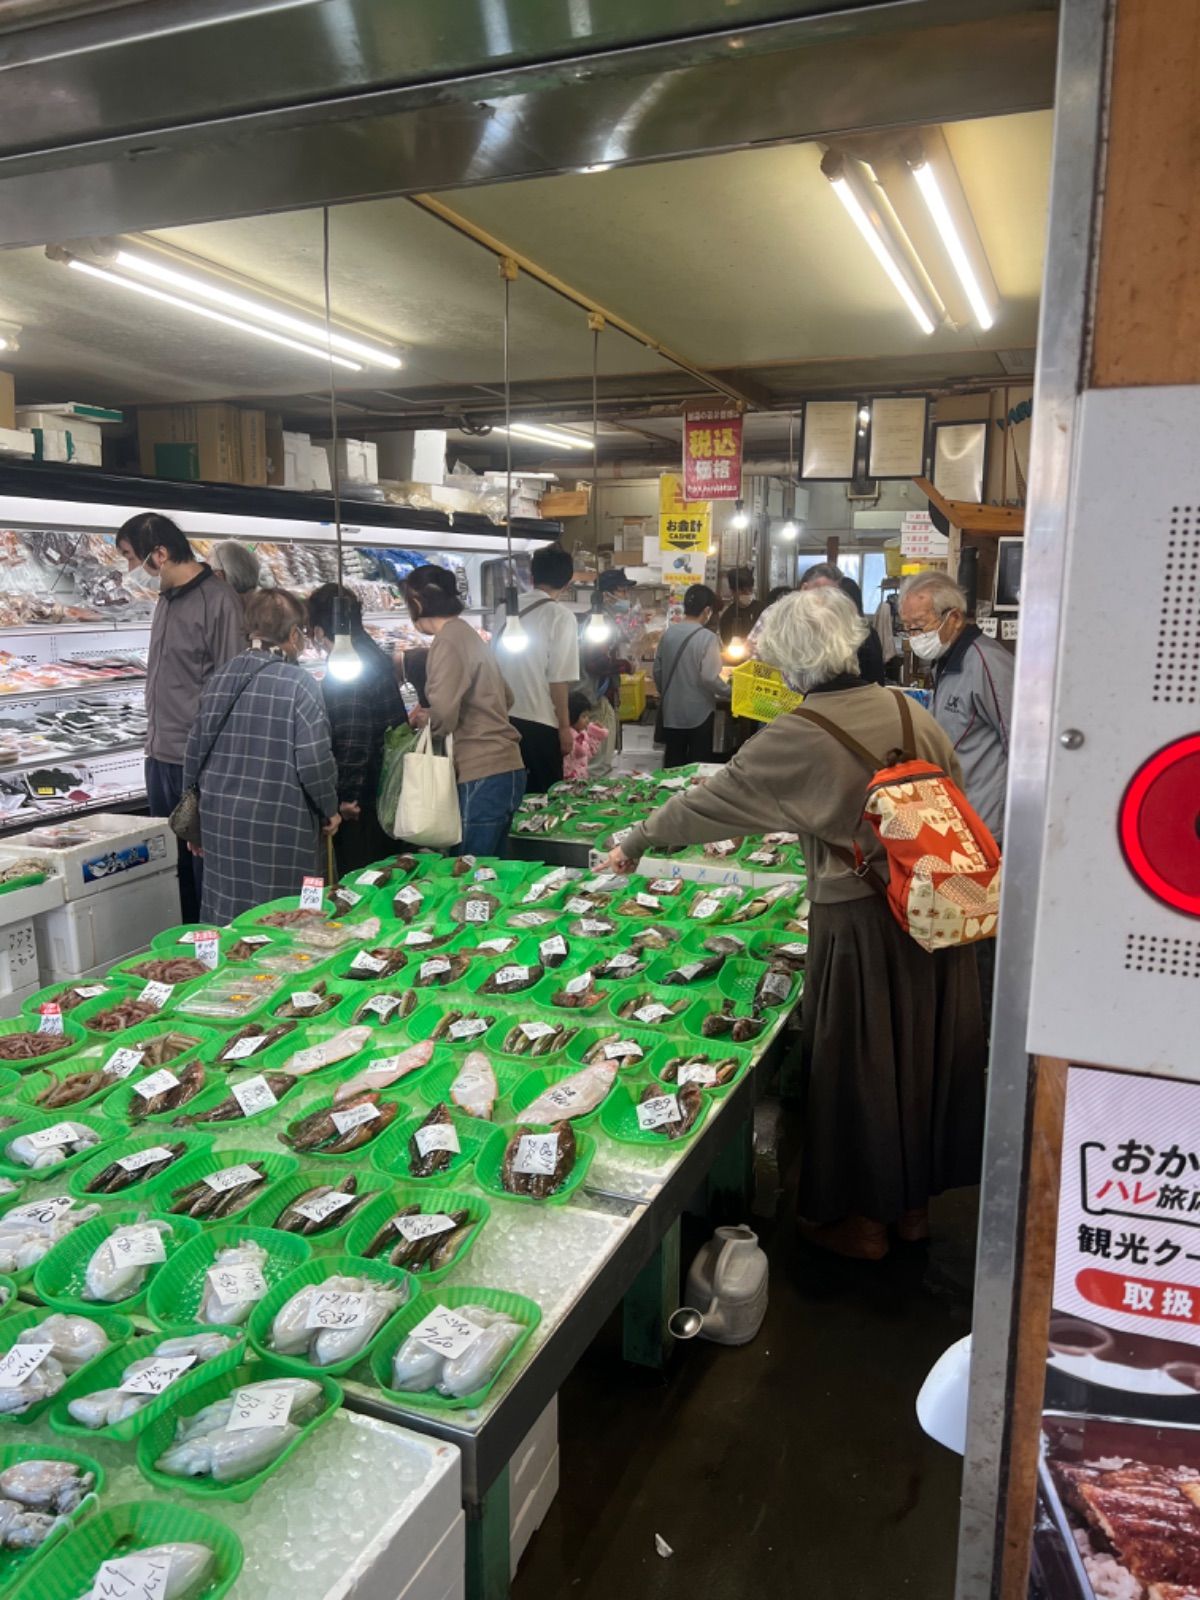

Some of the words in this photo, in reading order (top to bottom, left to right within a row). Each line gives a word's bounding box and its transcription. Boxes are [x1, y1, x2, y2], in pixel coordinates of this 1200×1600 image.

[688, 428, 736, 458] 税込
[696, 460, 731, 481] 価格
[666, 519, 703, 533] お会計
[1122, 1281, 1194, 1318] 取扱
